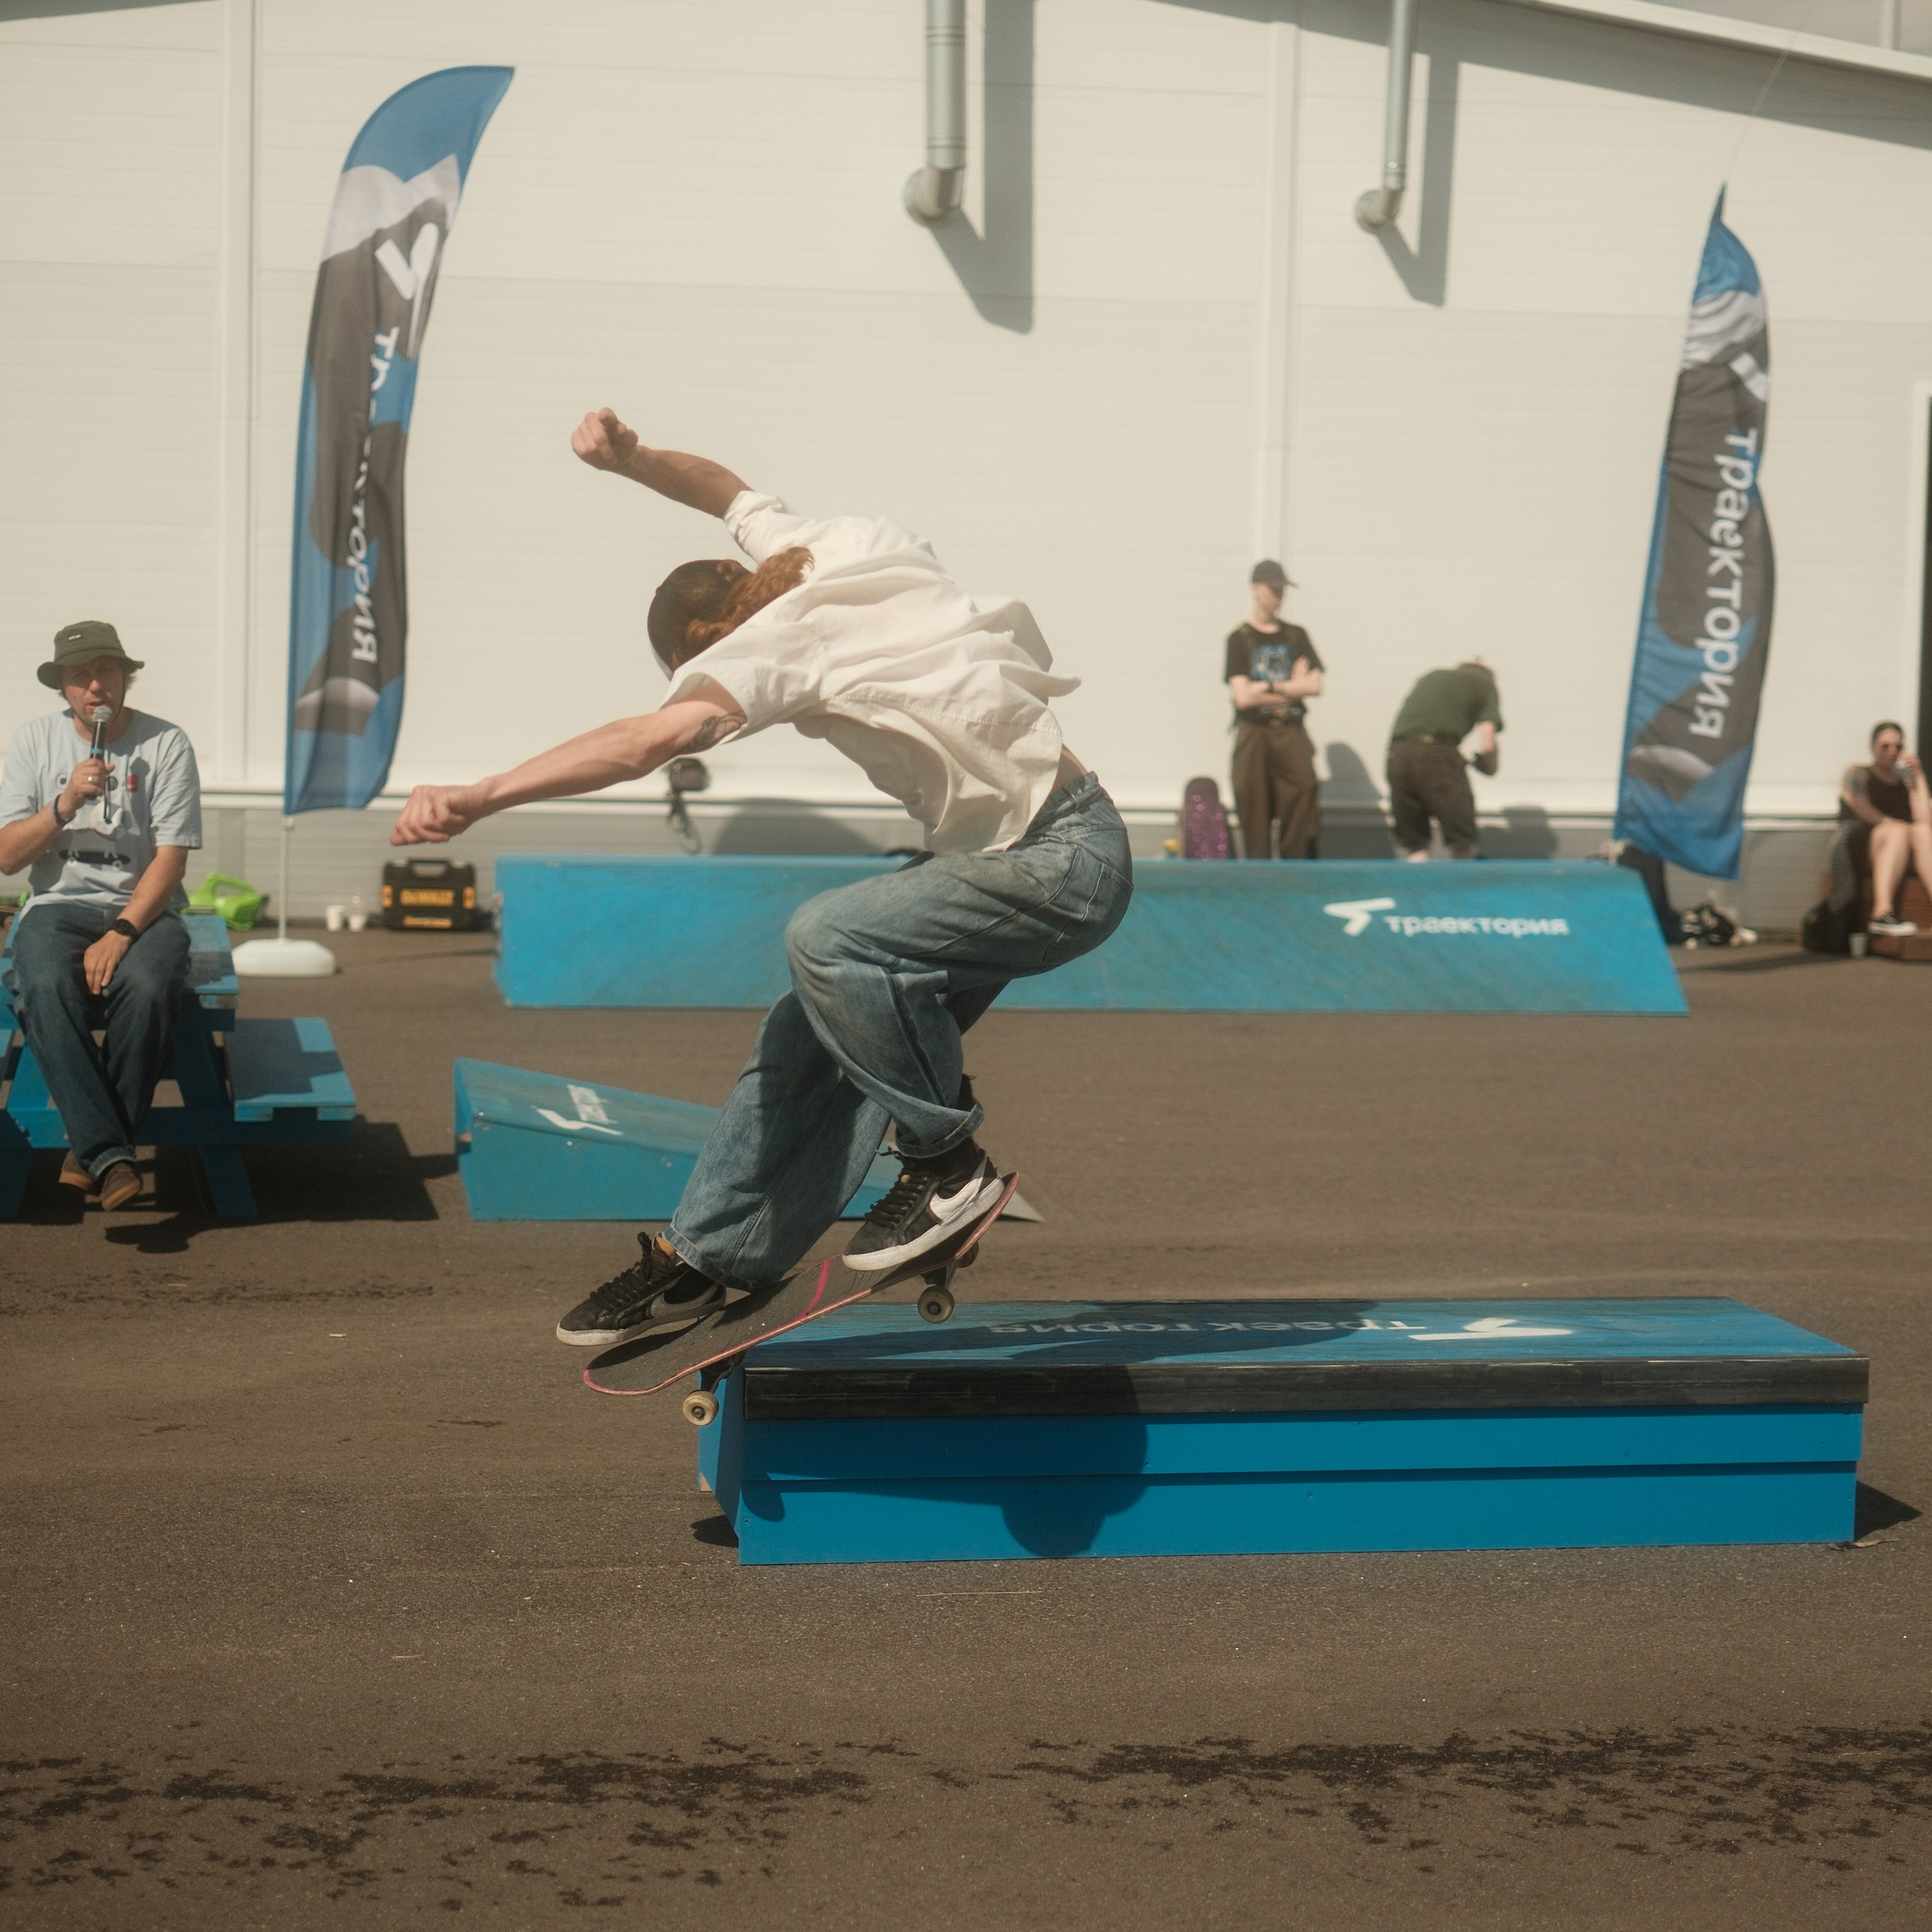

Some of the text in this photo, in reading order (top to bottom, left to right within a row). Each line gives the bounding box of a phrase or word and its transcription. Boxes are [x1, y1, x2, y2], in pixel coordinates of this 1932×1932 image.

[1688, 429, 1759, 738] траектория
[1386, 915, 1569, 938] траектория
[989, 1318, 1426, 1334] траектория
